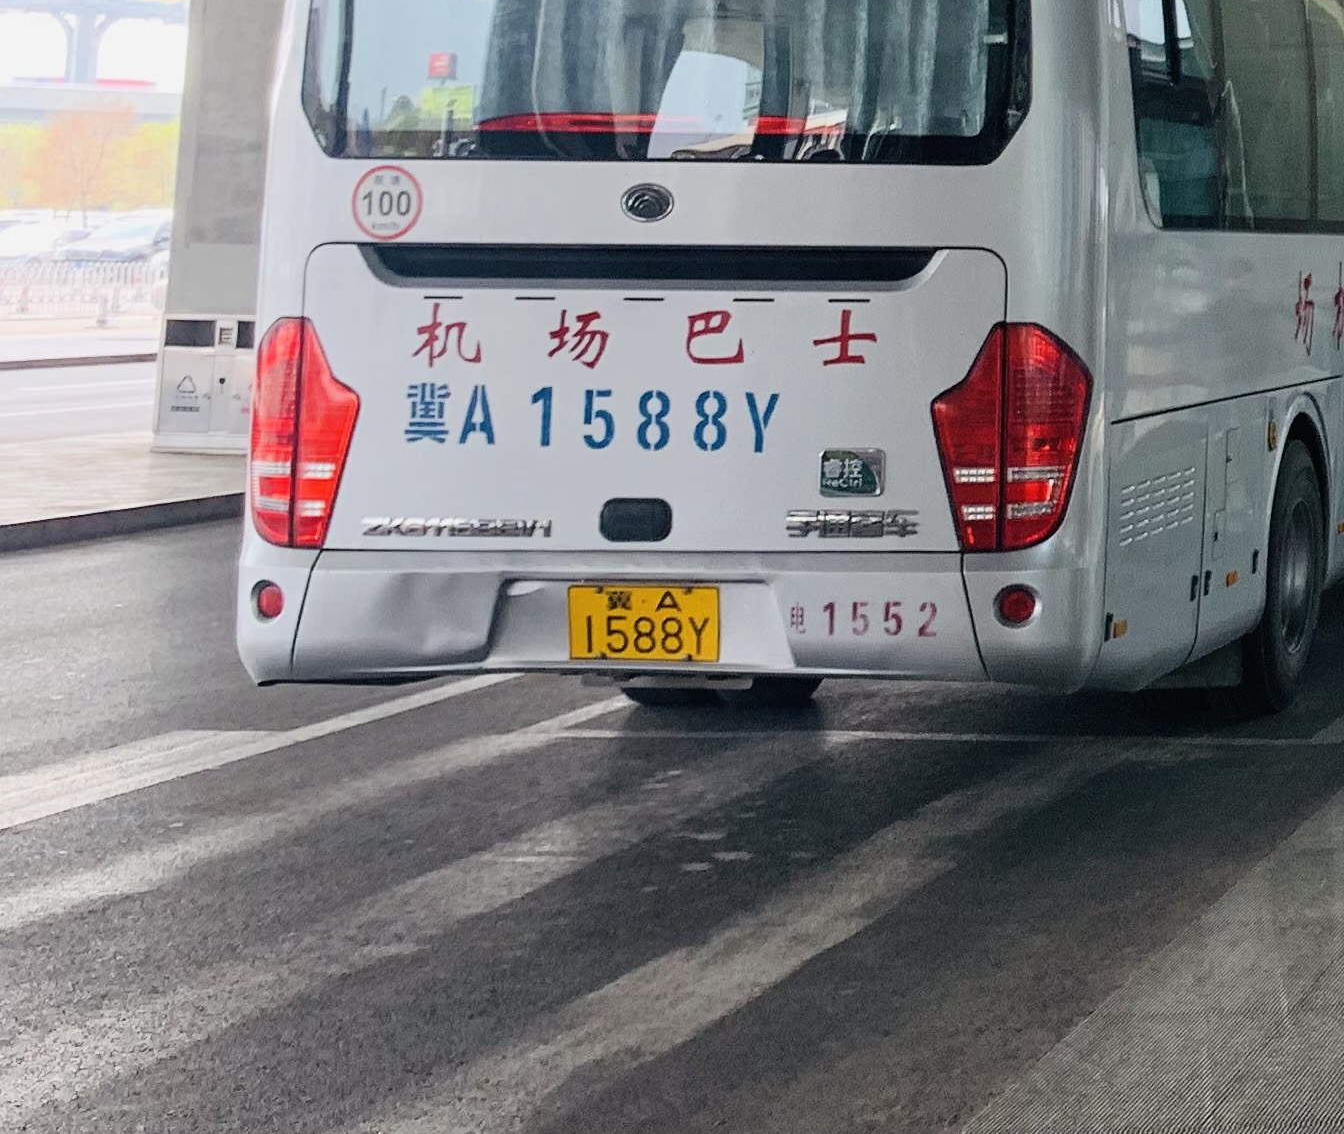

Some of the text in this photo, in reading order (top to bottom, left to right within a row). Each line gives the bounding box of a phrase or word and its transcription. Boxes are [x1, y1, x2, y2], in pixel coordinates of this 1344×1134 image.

[362, 190, 411, 216] 100
[411, 302, 877, 369] 机场巴士
[585, 615, 710, 655] 1588Y
